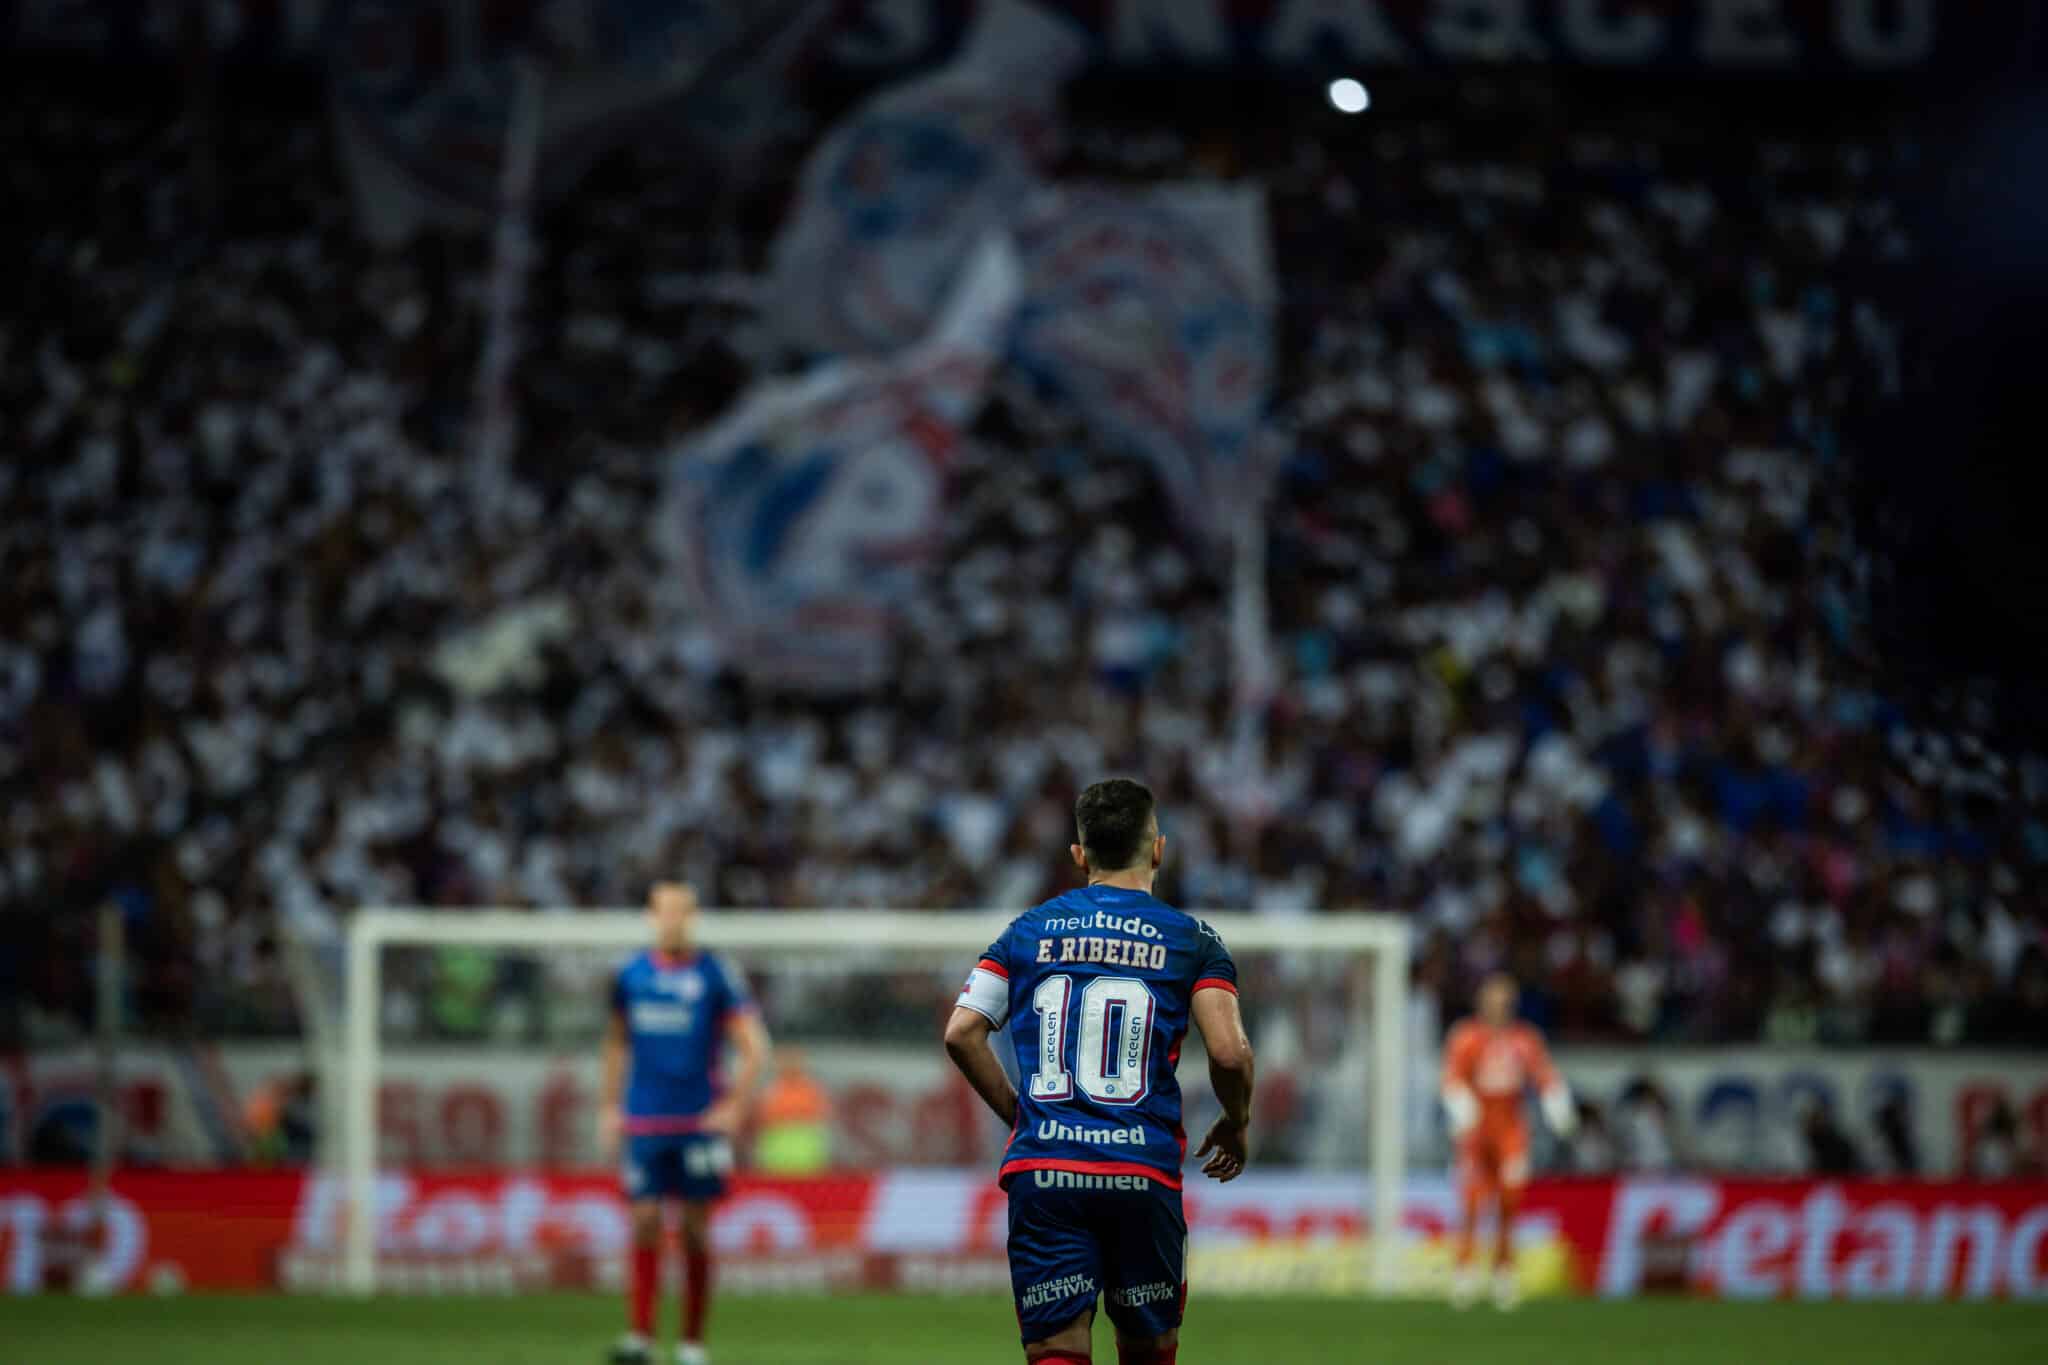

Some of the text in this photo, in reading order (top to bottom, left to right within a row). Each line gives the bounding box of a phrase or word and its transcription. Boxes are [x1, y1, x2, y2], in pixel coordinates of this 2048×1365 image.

[1045, 911, 1163, 940] meutudo.
[1060, 937, 1167, 970] RIBEIRO
[1029, 975, 1156, 1106] 10
[1047, 1011, 1057, 1063] acelen
[1127, 1016, 1142, 1068] acelen
[1038, 1119, 1146, 1145] Unimed
[1034, 1170, 1149, 1191] Unimed
[1022, 1278, 1095, 1310] MULTIVIX
